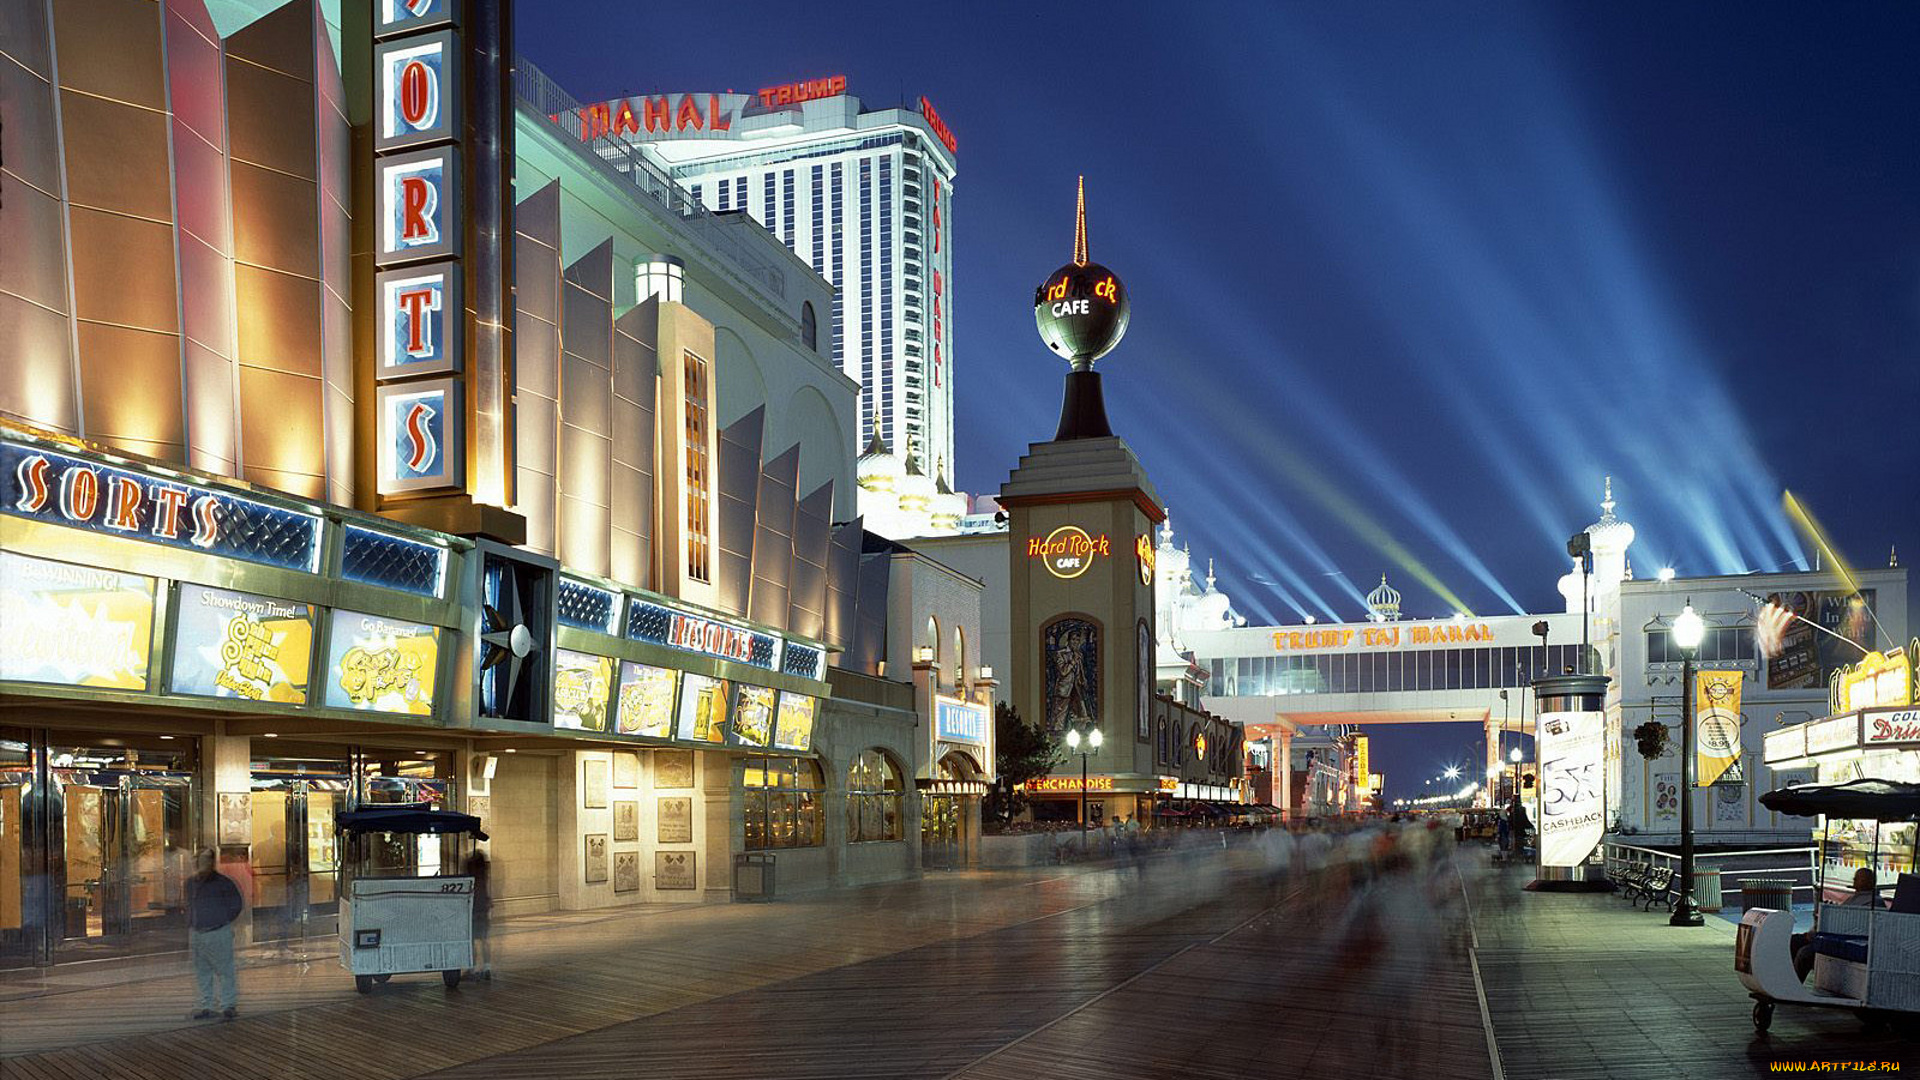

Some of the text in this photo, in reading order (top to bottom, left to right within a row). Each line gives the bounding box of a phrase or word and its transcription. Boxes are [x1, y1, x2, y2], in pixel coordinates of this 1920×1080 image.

[757, 75, 846, 107] TRUMP
[579, 93, 733, 142] MAHAL
[921, 96, 957, 153] TRUMP
[399, 0, 442, 474] ORTS
[1051, 299, 1090, 318] CAFE
[16, 455, 220, 548] SORTS
[1028, 534, 1110, 557] Hard Rock
[1056, 557, 1080, 569] CAFE
[200, 591, 297, 620] Showdown Time!
[360, 618, 375, 631] Go
[1273, 623, 1495, 650] TRUMP TAJ MAHAL
[1025, 778, 1112, 790] MERCHANDISE
[1542, 812, 1602, 832] CASHBACK
